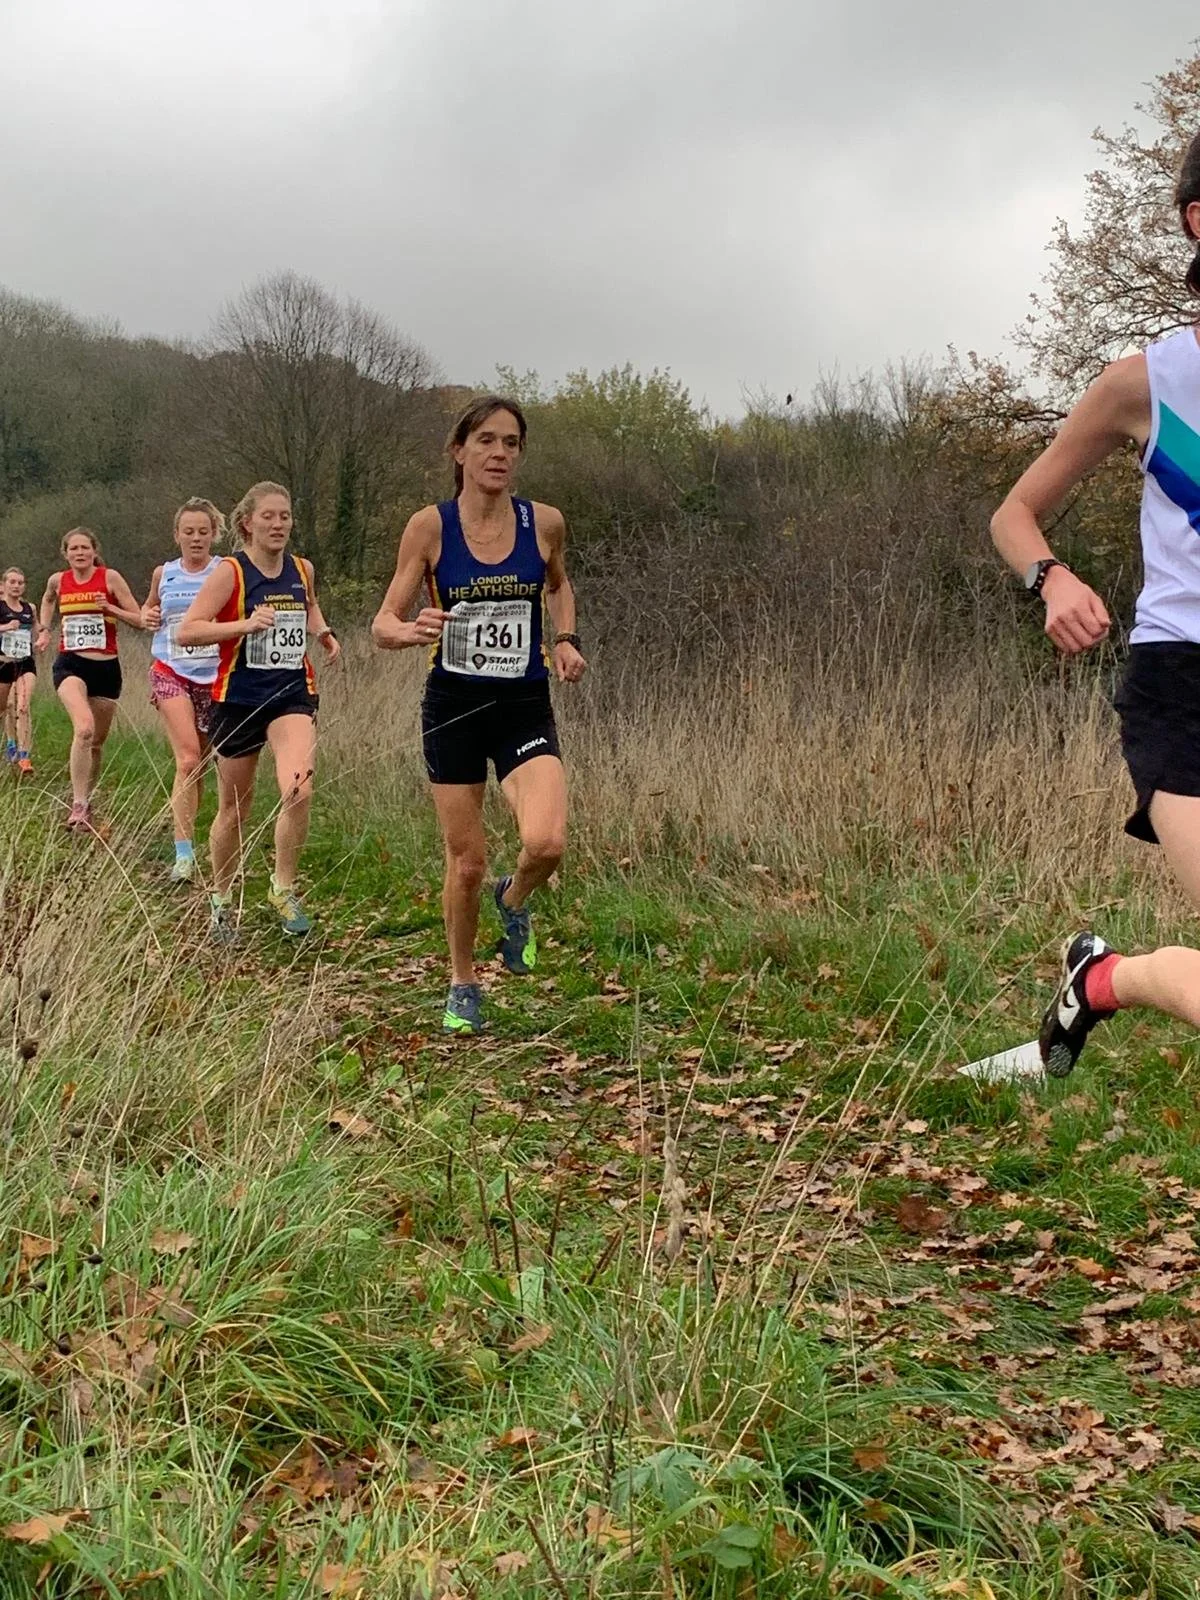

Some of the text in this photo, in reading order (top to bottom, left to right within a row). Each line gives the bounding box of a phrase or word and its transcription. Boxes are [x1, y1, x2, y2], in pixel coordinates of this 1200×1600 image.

[518, 503, 530, 528] soar
[470, 574, 518, 586] LONDON
[448, 583, 538, 599] HEATHSIDE
[254, 602, 305, 610] ATHSIDE
[78, 623, 103, 635] 1885
[475, 623, 522, 649] 1361
[272, 628, 304, 647] 1363
[488, 656, 521, 665] START
[516, 737, 548, 756] HOKA
